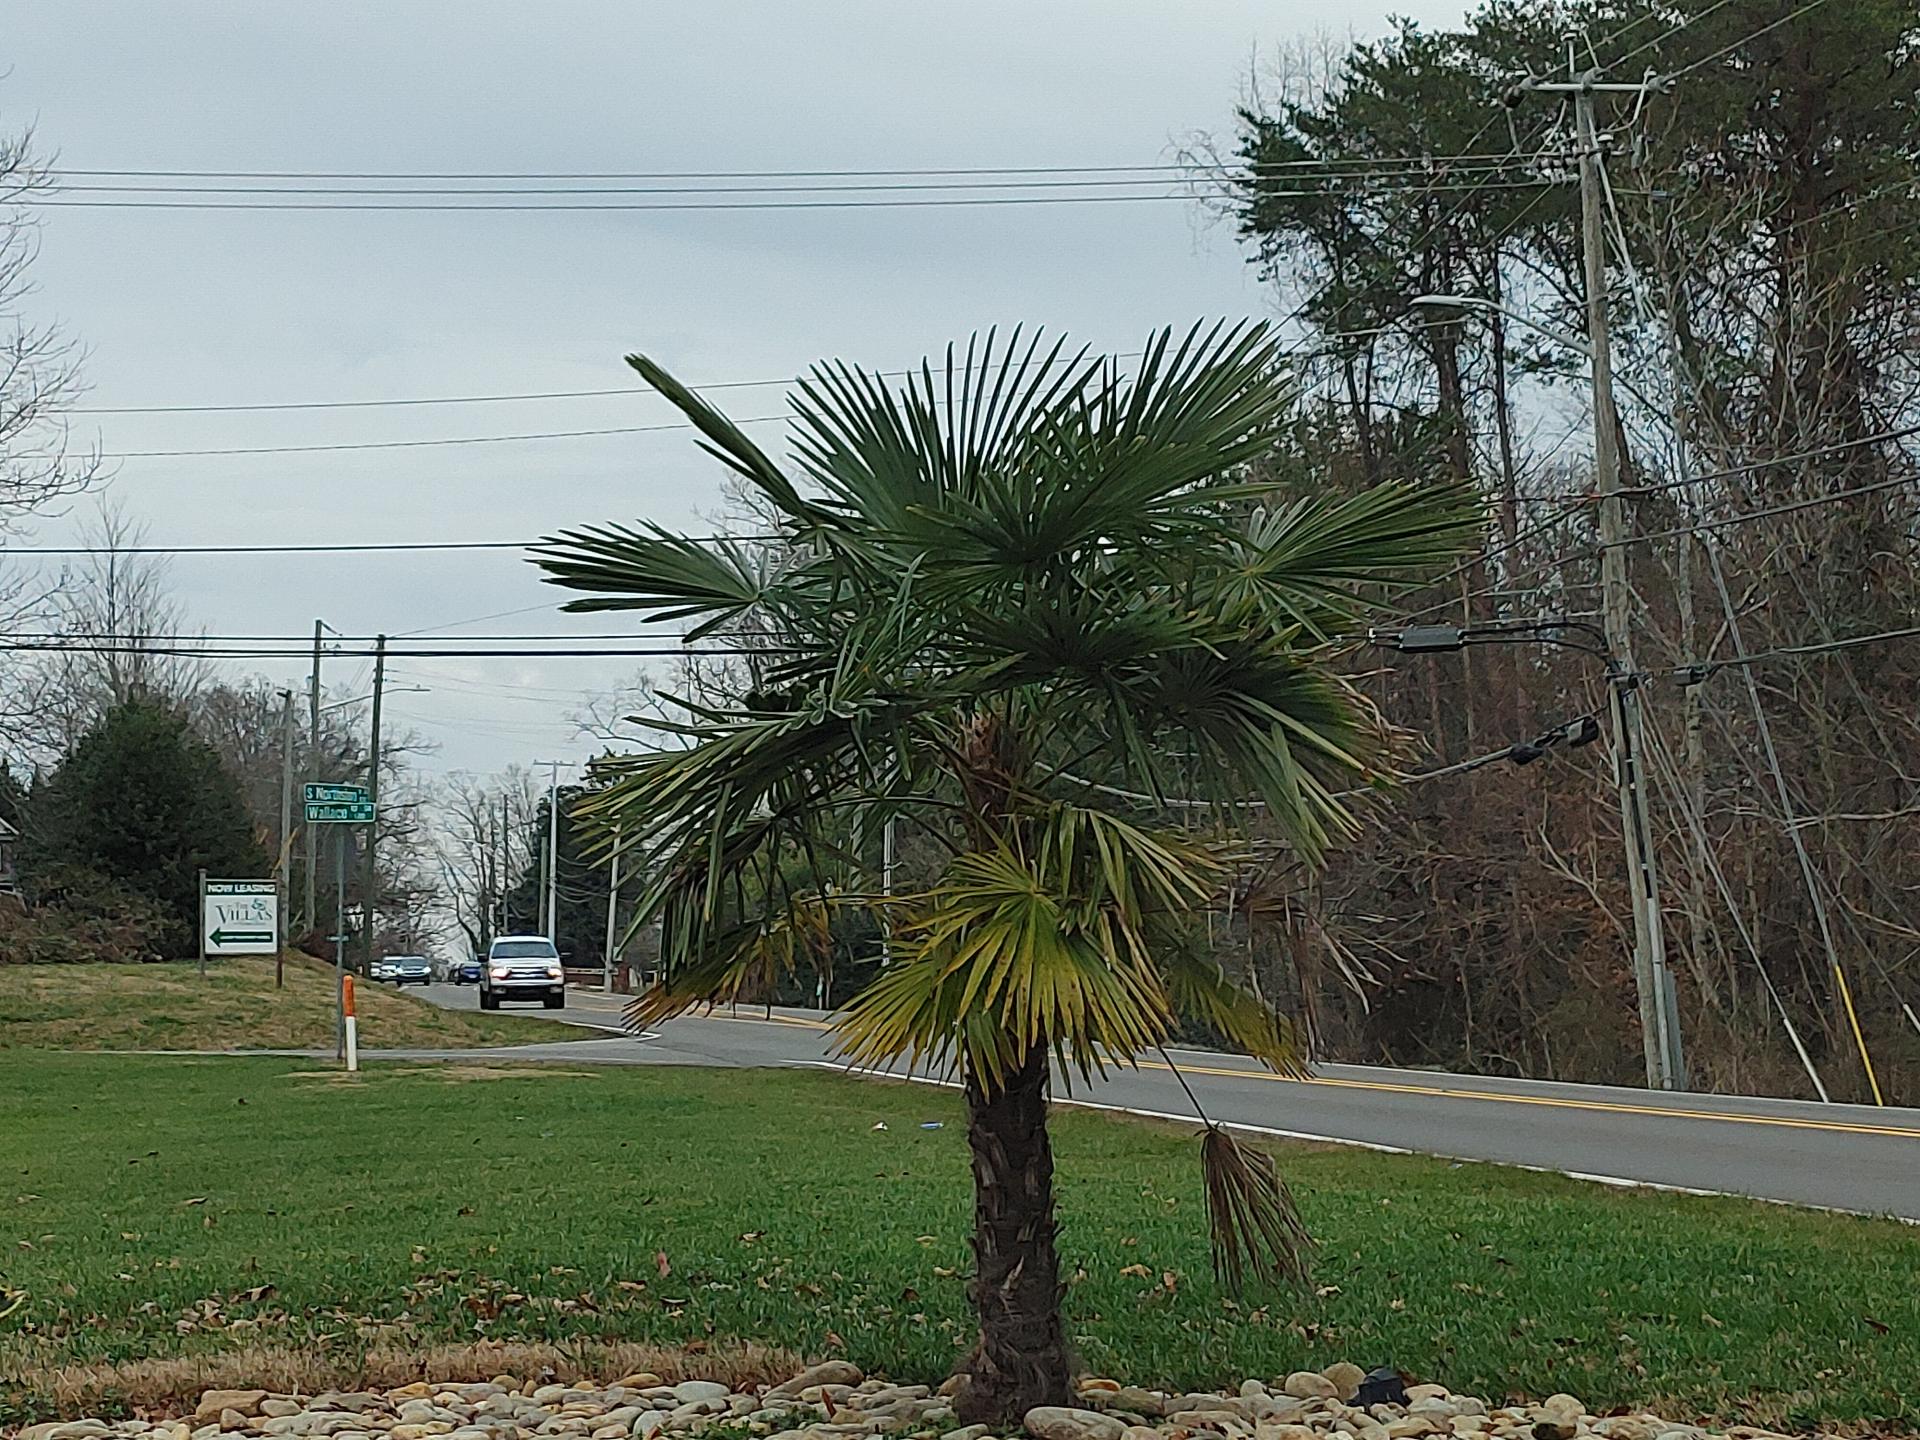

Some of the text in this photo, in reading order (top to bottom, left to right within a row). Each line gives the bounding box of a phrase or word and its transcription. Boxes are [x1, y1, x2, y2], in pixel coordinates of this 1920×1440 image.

[306, 787, 313, 799] S
[207, 884, 276, 893] NOW LEASING
